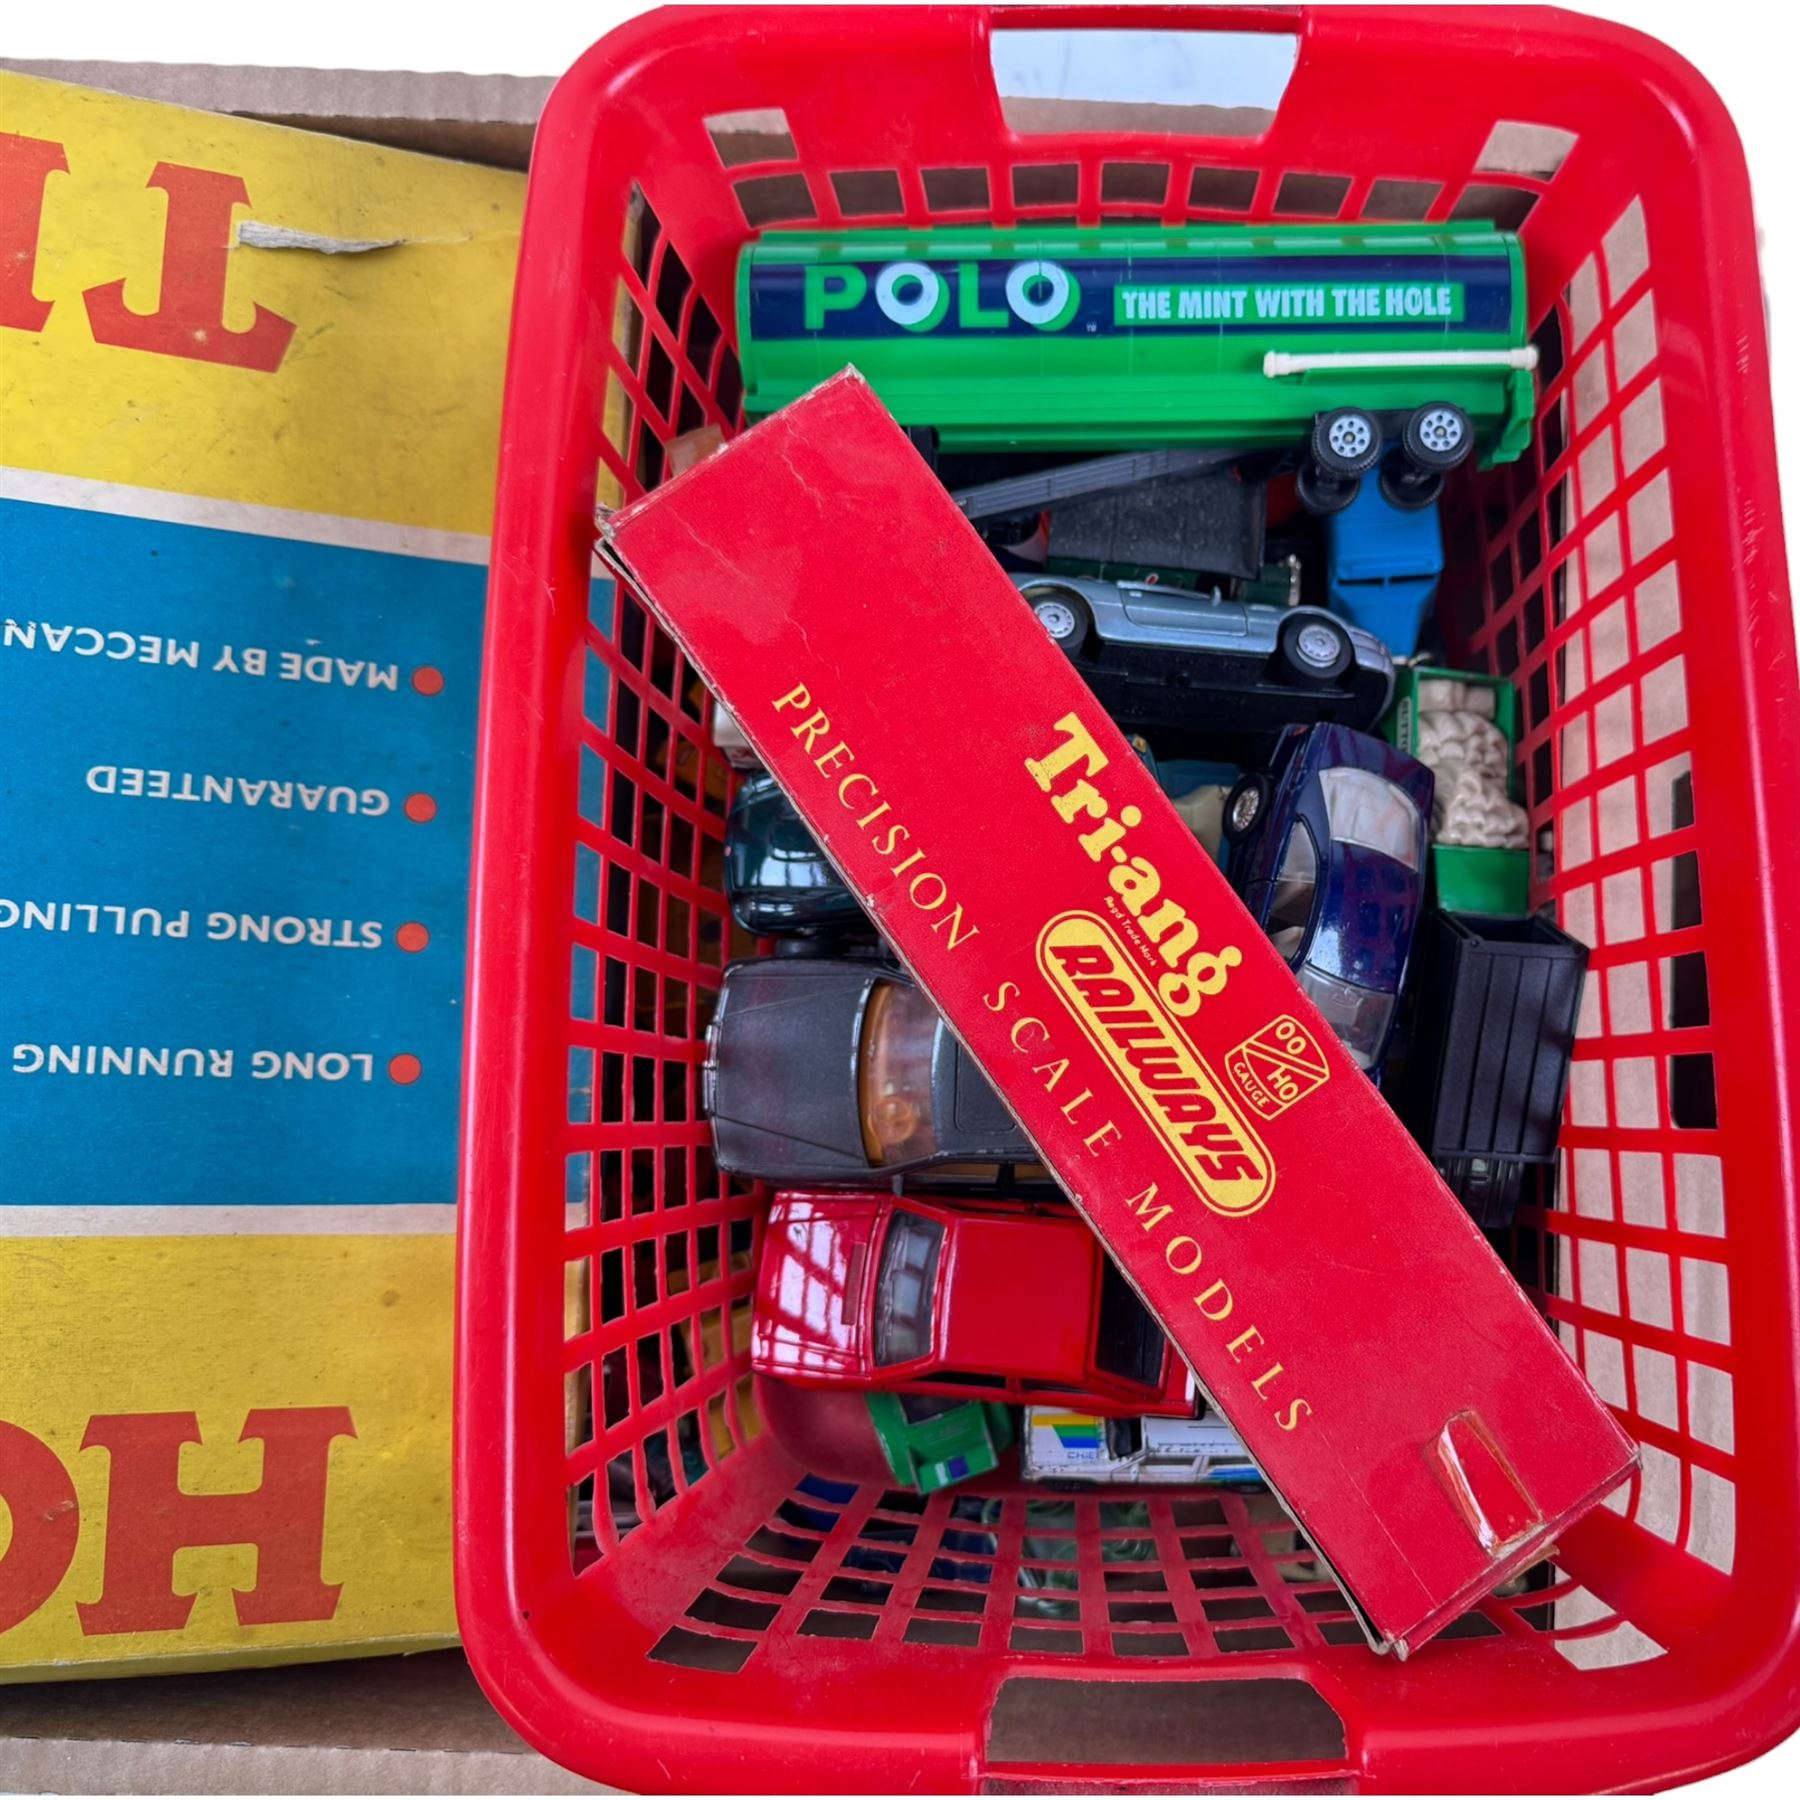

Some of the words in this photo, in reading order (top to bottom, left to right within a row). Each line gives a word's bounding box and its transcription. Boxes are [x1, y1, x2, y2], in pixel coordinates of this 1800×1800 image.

[805, 260, 1081, 332] POLO
[1122, 290, 1171, 319] THE
[1178, 290, 1247, 319] MINT
[1254, 289, 1324, 317] WITH
[1331, 288, 1380, 317] THE
[1385, 287, 1452, 316] HOLE
[3, 618, 199, 668] MECCAN
[213, 644, 267, 676] BY
[281, 652, 398, 690] MADE
[86, 765, 390, 816] GUARANTEED
[1024, 711, 1243, 1017] Tri-ang
[0, 899, 190, 938] PULLING
[207, 911, 383, 949] STRONG
[1122, 919, 1141, 945] Trade
[1139, 944, 1157, 967] Mark
[12, 1043, 234, 1077] RUNNING
[251, 1050, 374, 1082] LONG
[771, 683, 980, 951] PRECISION
[983, 981, 1122, 1157] SCALE
[1126, 1182, 1313, 1431] MODELS
[1048, 945, 1265, 1181] RAILWAYS
[1233, 1062, 1270, 1107] GAUGE
[1266, 1066, 1298, 1100] HO
